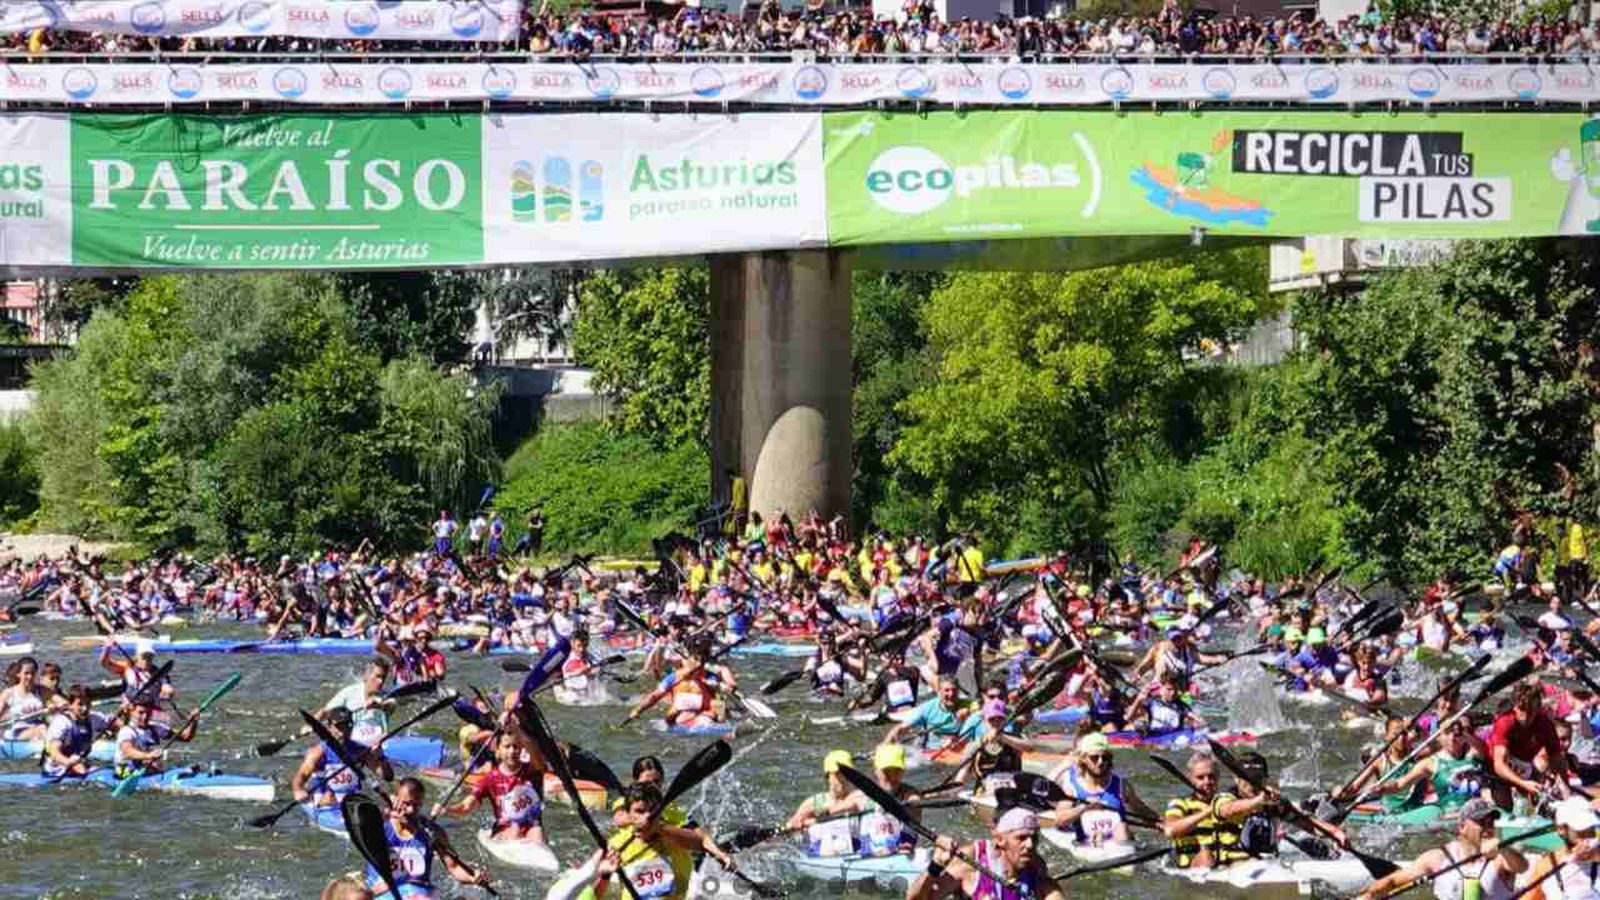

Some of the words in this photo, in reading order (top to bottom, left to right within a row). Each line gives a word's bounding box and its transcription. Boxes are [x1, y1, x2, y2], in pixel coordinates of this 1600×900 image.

[181, 11, 222, 22] SELLA
[288, 10, 330, 24] SELLA
[218, 76, 258, 88] SELLA
[322, 77, 361, 88] SELLA
[428, 76, 466, 88] SELLA
[531, 76, 570, 88] SELLA
[635, 76, 676, 88] SELLA
[740, 77, 778, 88] SELLA
[841, 76, 880, 89] SELLA
[942, 76, 982, 86] SELLA
[1046, 77, 1084, 89] SELLA
[1149, 76, 1188, 88] SELLA
[1251, 77, 1289, 88] SELLA
[1352, 76, 1391, 88] SELLA
[1457, 77, 1492, 88] SELLA
[223, 123, 301, 147] Vuelve
[307, 120, 334, 146] al
[1246, 132, 1425, 175] RECICLA
[1432, 154, 1469, 175] TUS
[629, 154, 797, 191] Asturias
[87, 149, 466, 211] PARAÍSO
[720, 191, 798, 209] natural
[1373, 183, 1493, 218] PILAS
[142, 234, 220, 261] Vuelve
[227, 243, 241, 260] a
[250, 237, 320, 261] sentir
[326, 236, 429, 262] Asturias
[637, 867, 664, 887] 539
